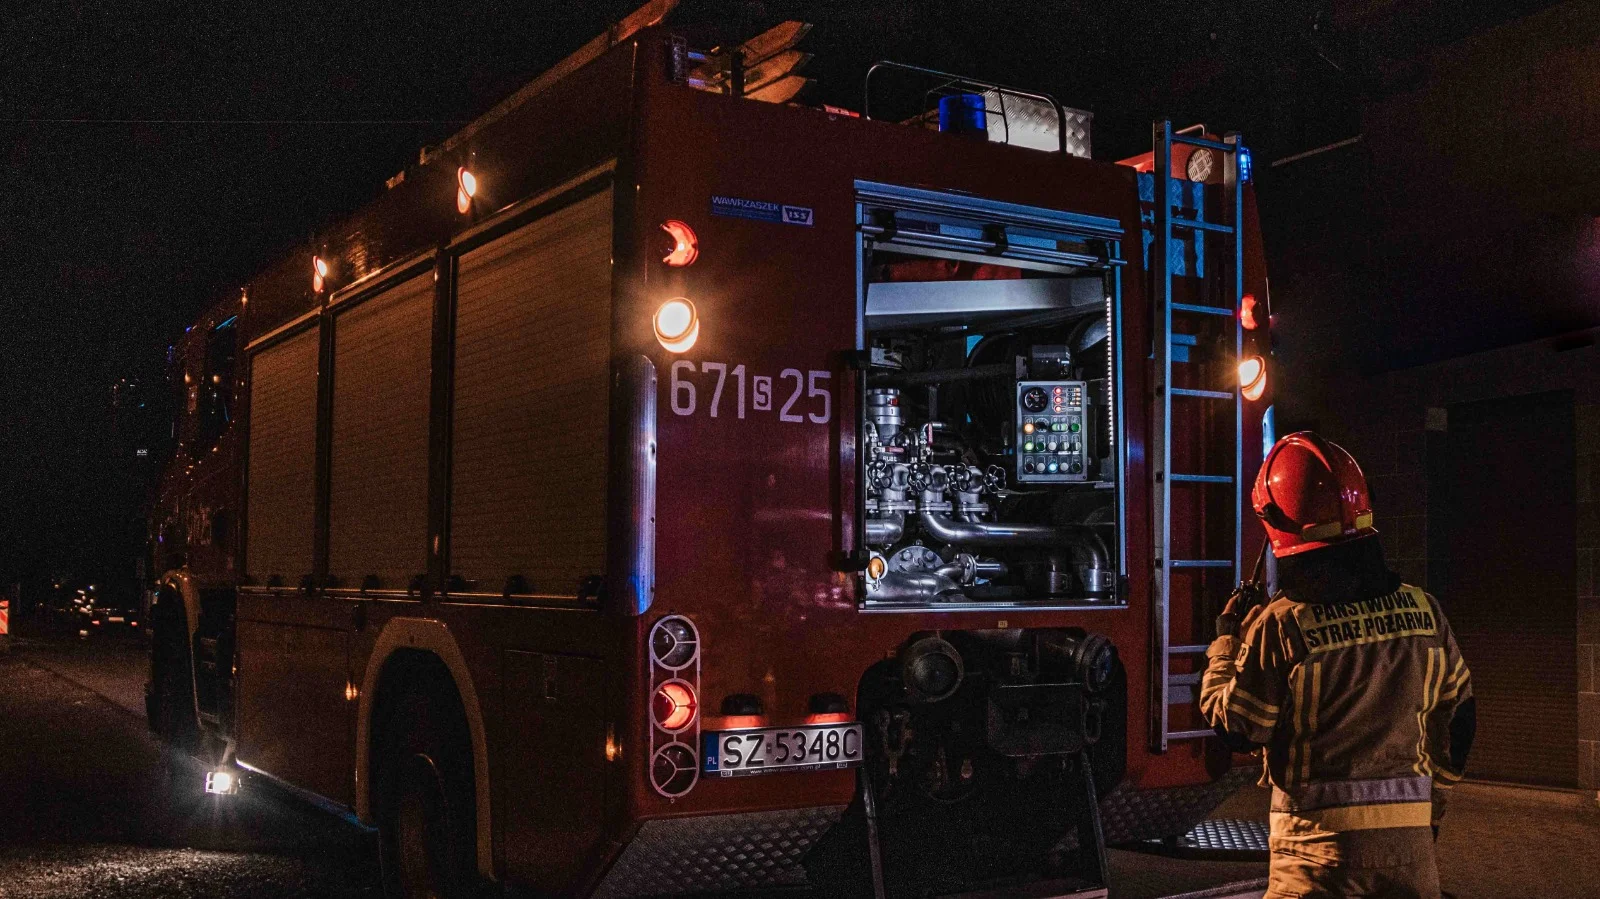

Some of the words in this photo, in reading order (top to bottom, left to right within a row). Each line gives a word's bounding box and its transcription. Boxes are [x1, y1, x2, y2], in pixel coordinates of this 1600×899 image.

[712, 195, 780, 211] WAWRZASZEK
[723, 734, 765, 768] SZ
[774, 728, 858, 764] 5348C
[706, 756, 717, 765] PL
